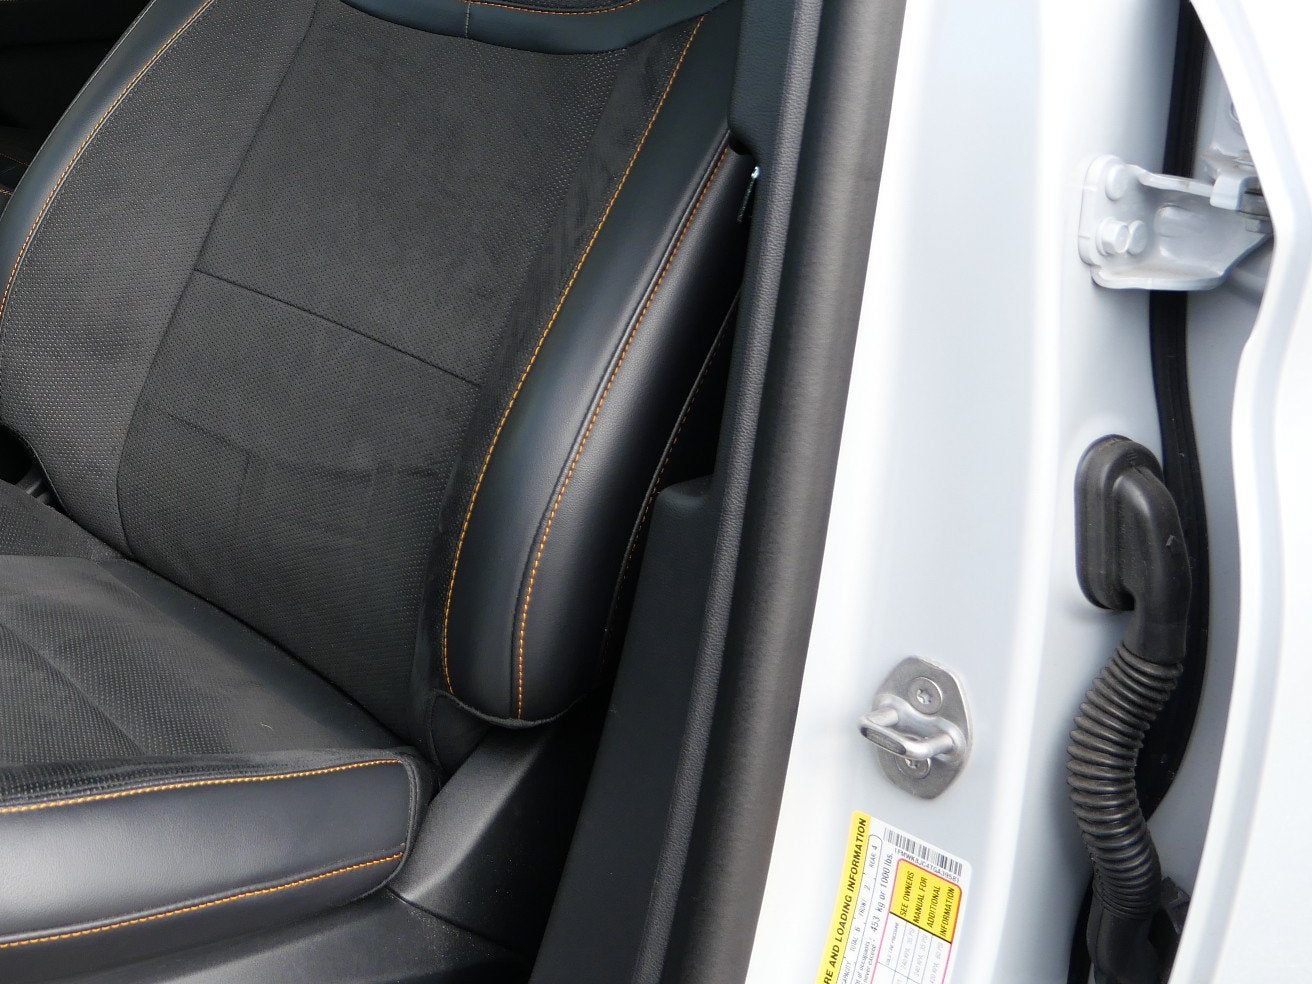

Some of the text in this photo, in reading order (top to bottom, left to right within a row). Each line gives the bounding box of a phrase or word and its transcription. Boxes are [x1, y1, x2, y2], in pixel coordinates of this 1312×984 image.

[847, 817, 867, 893] INFORMATION
[875, 901, 885, 912] kg
[880, 866, 891, 888] 1000
[900, 871, 914, 917] SEE OWNERS
[913, 876, 928, 924] MANUAL FOR
[927, 886, 941, 928] ADDITIONAL
[940, 886, 955, 937] INFORMATION
[834, 895, 852, 943] LOADING
[829, 944, 840, 968] AND
